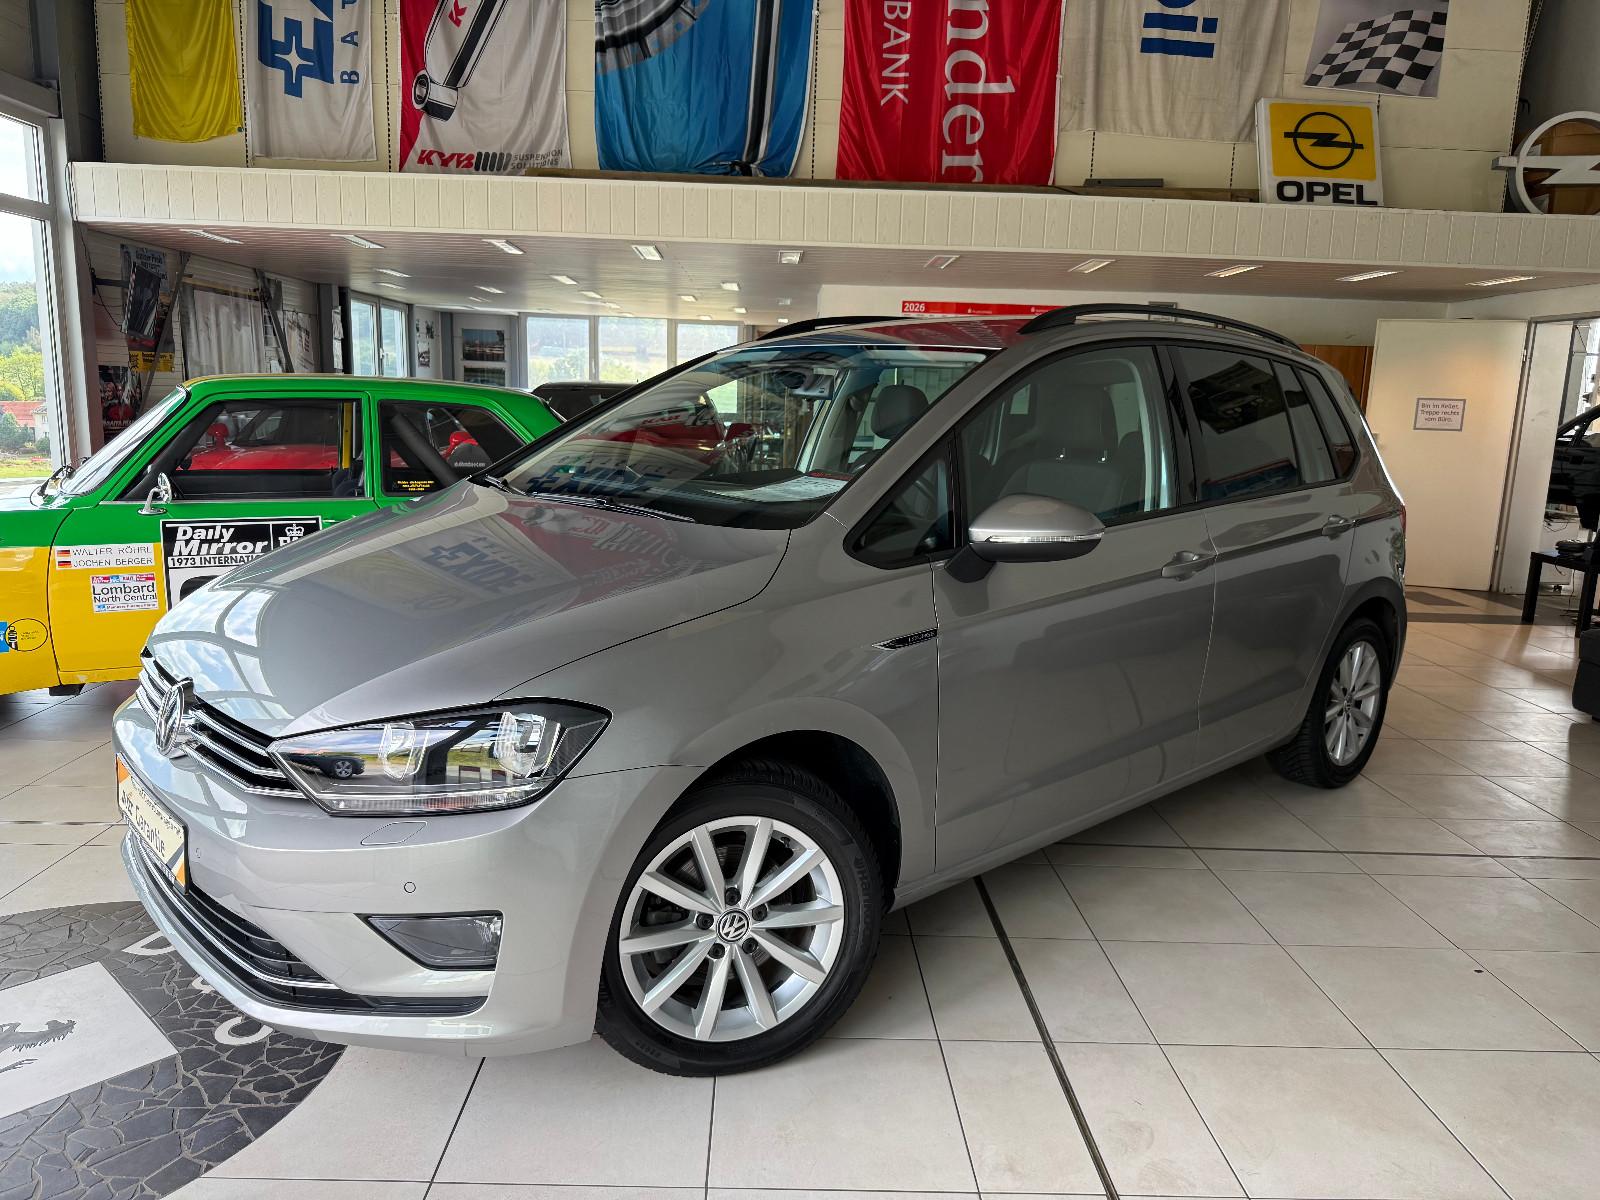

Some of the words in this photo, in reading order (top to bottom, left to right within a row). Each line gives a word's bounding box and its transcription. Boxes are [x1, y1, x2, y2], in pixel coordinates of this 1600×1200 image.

[880, 0, 912, 107] BANK
[941, 0, 1016, 183] nder
[416, 150, 475, 169] KYB
[1276, 181, 1378, 206] OPEL
[903, 302, 926, 312] 2026
[176, 525, 235, 543] Daily
[72, 547, 113, 556] WALTER
[118, 545, 153, 555] RÖHRL
[172, 539, 268, 557] Mirror
[73, 559, 111, 568] JOCHEN
[115, 557, 153, 566] BERGER
[170, 557, 197, 567] 1973
[92, 582, 155, 596] Lombard
[93, 594, 121, 604] North
[123, 592, 158, 602] Central
